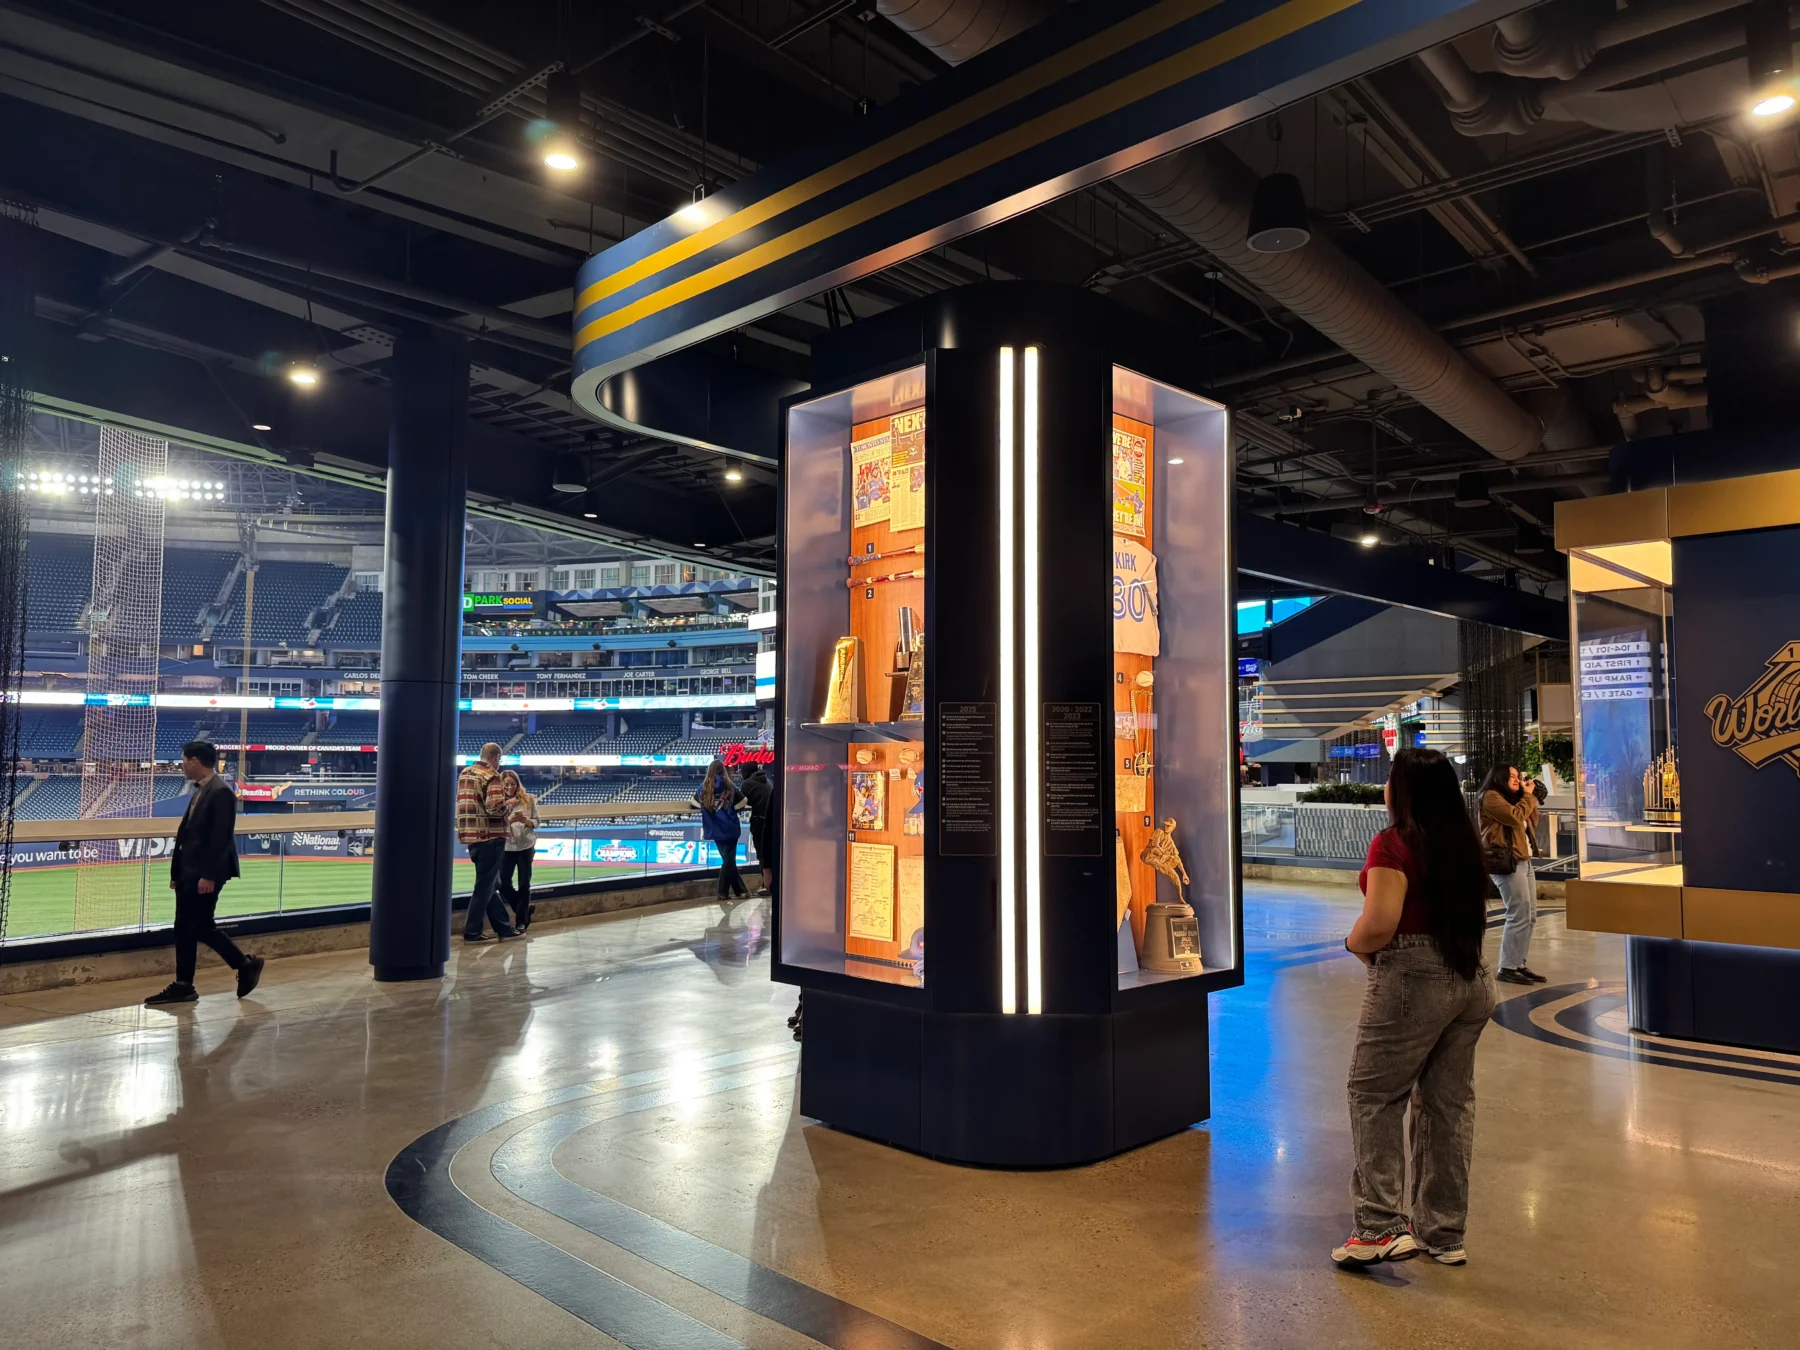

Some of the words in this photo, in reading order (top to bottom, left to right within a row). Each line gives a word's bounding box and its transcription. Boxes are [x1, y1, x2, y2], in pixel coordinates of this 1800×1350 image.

[868, 544, 873, 553] 1
[1115, 552, 1137, 572] KIRK
[867, 589, 873, 598] 2
[475, 596, 503, 604] PARK
[503, 597, 533, 605] SOCIAL
[1788, 647, 1794, 658] 1
[1117, 673, 1122, 683] 4
[1125, 761, 1130, 770] 5
[294, 788, 330, 796] RETHINK
[331, 788, 365, 796] COLOUR
[848, 832, 855, 841] 11
[11, 851, 35, 865] you
[36, 850, 66, 862] want
[69, 848, 81, 858] to
[83, 846, 99, 858] be
